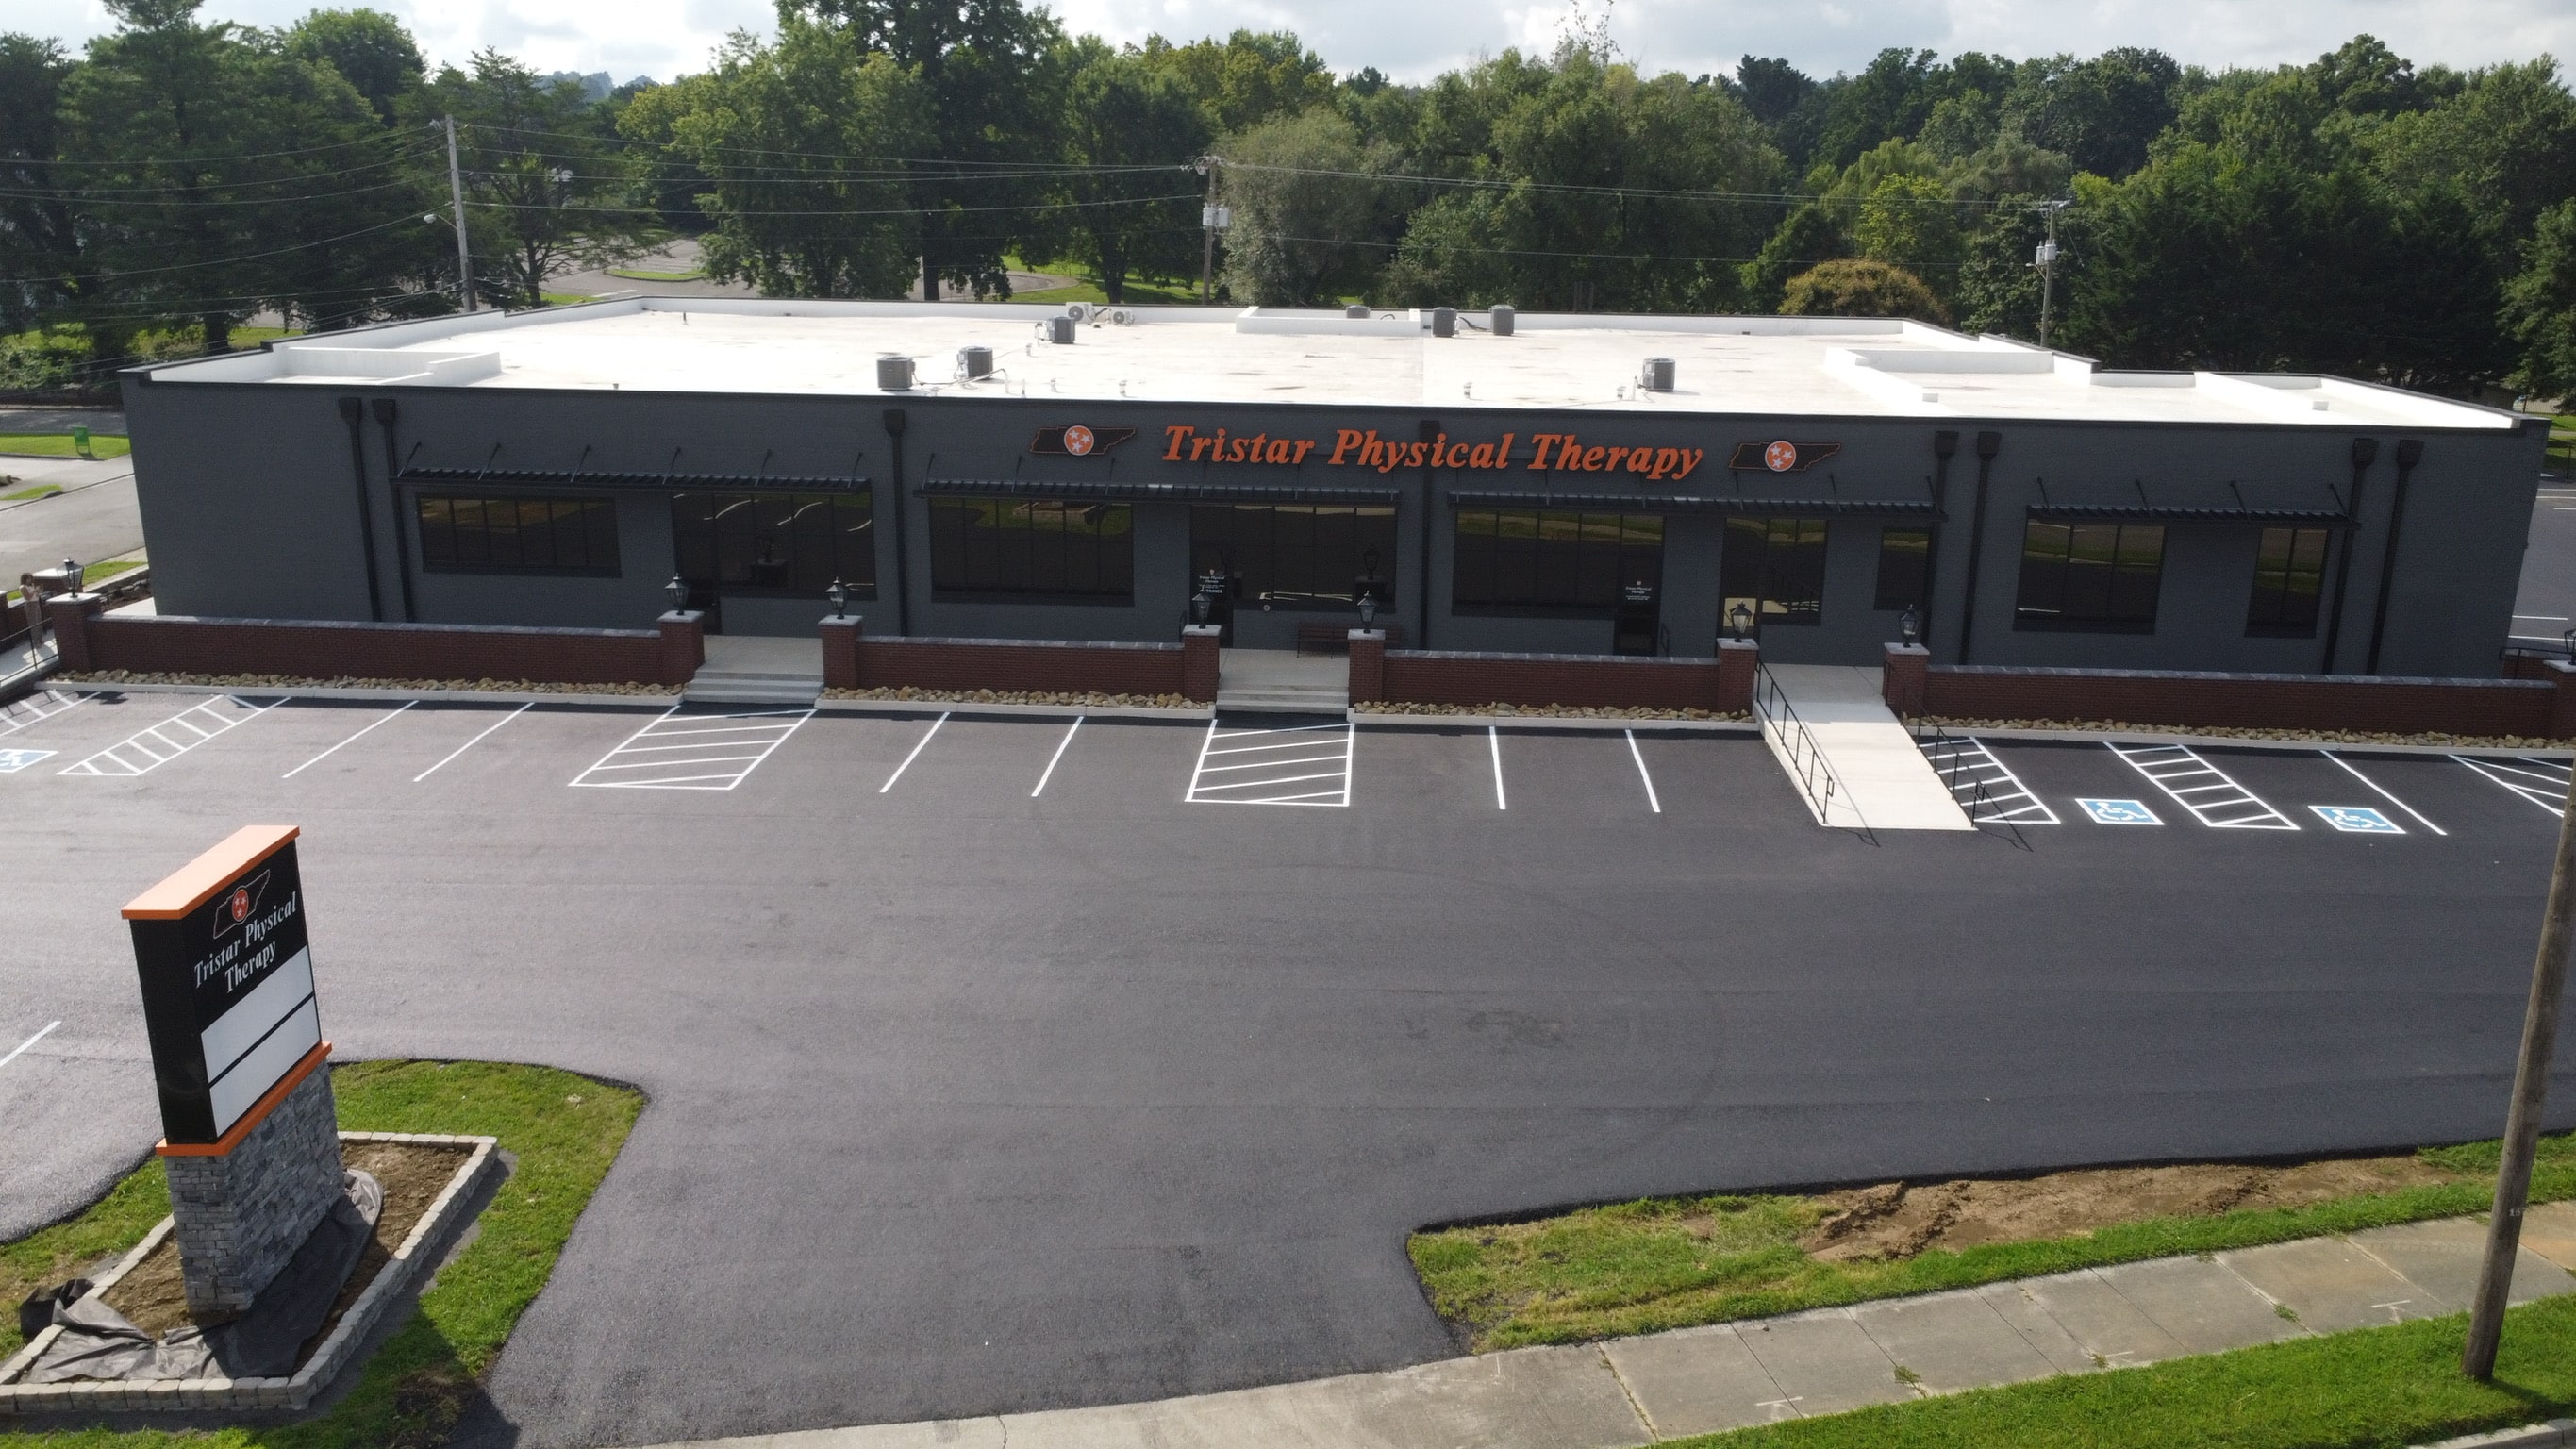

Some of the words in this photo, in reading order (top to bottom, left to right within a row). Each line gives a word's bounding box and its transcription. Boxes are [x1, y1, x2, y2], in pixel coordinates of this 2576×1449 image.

[1162, 425, 1315, 464] Tristar
[1327, 429, 1515, 473] Physical
[1527, 433, 1703, 480] Therapy
[194, 939, 241, 989] Tristar
[245, 890, 296, 948] Physical
[224, 941, 276, 993] Therapy
